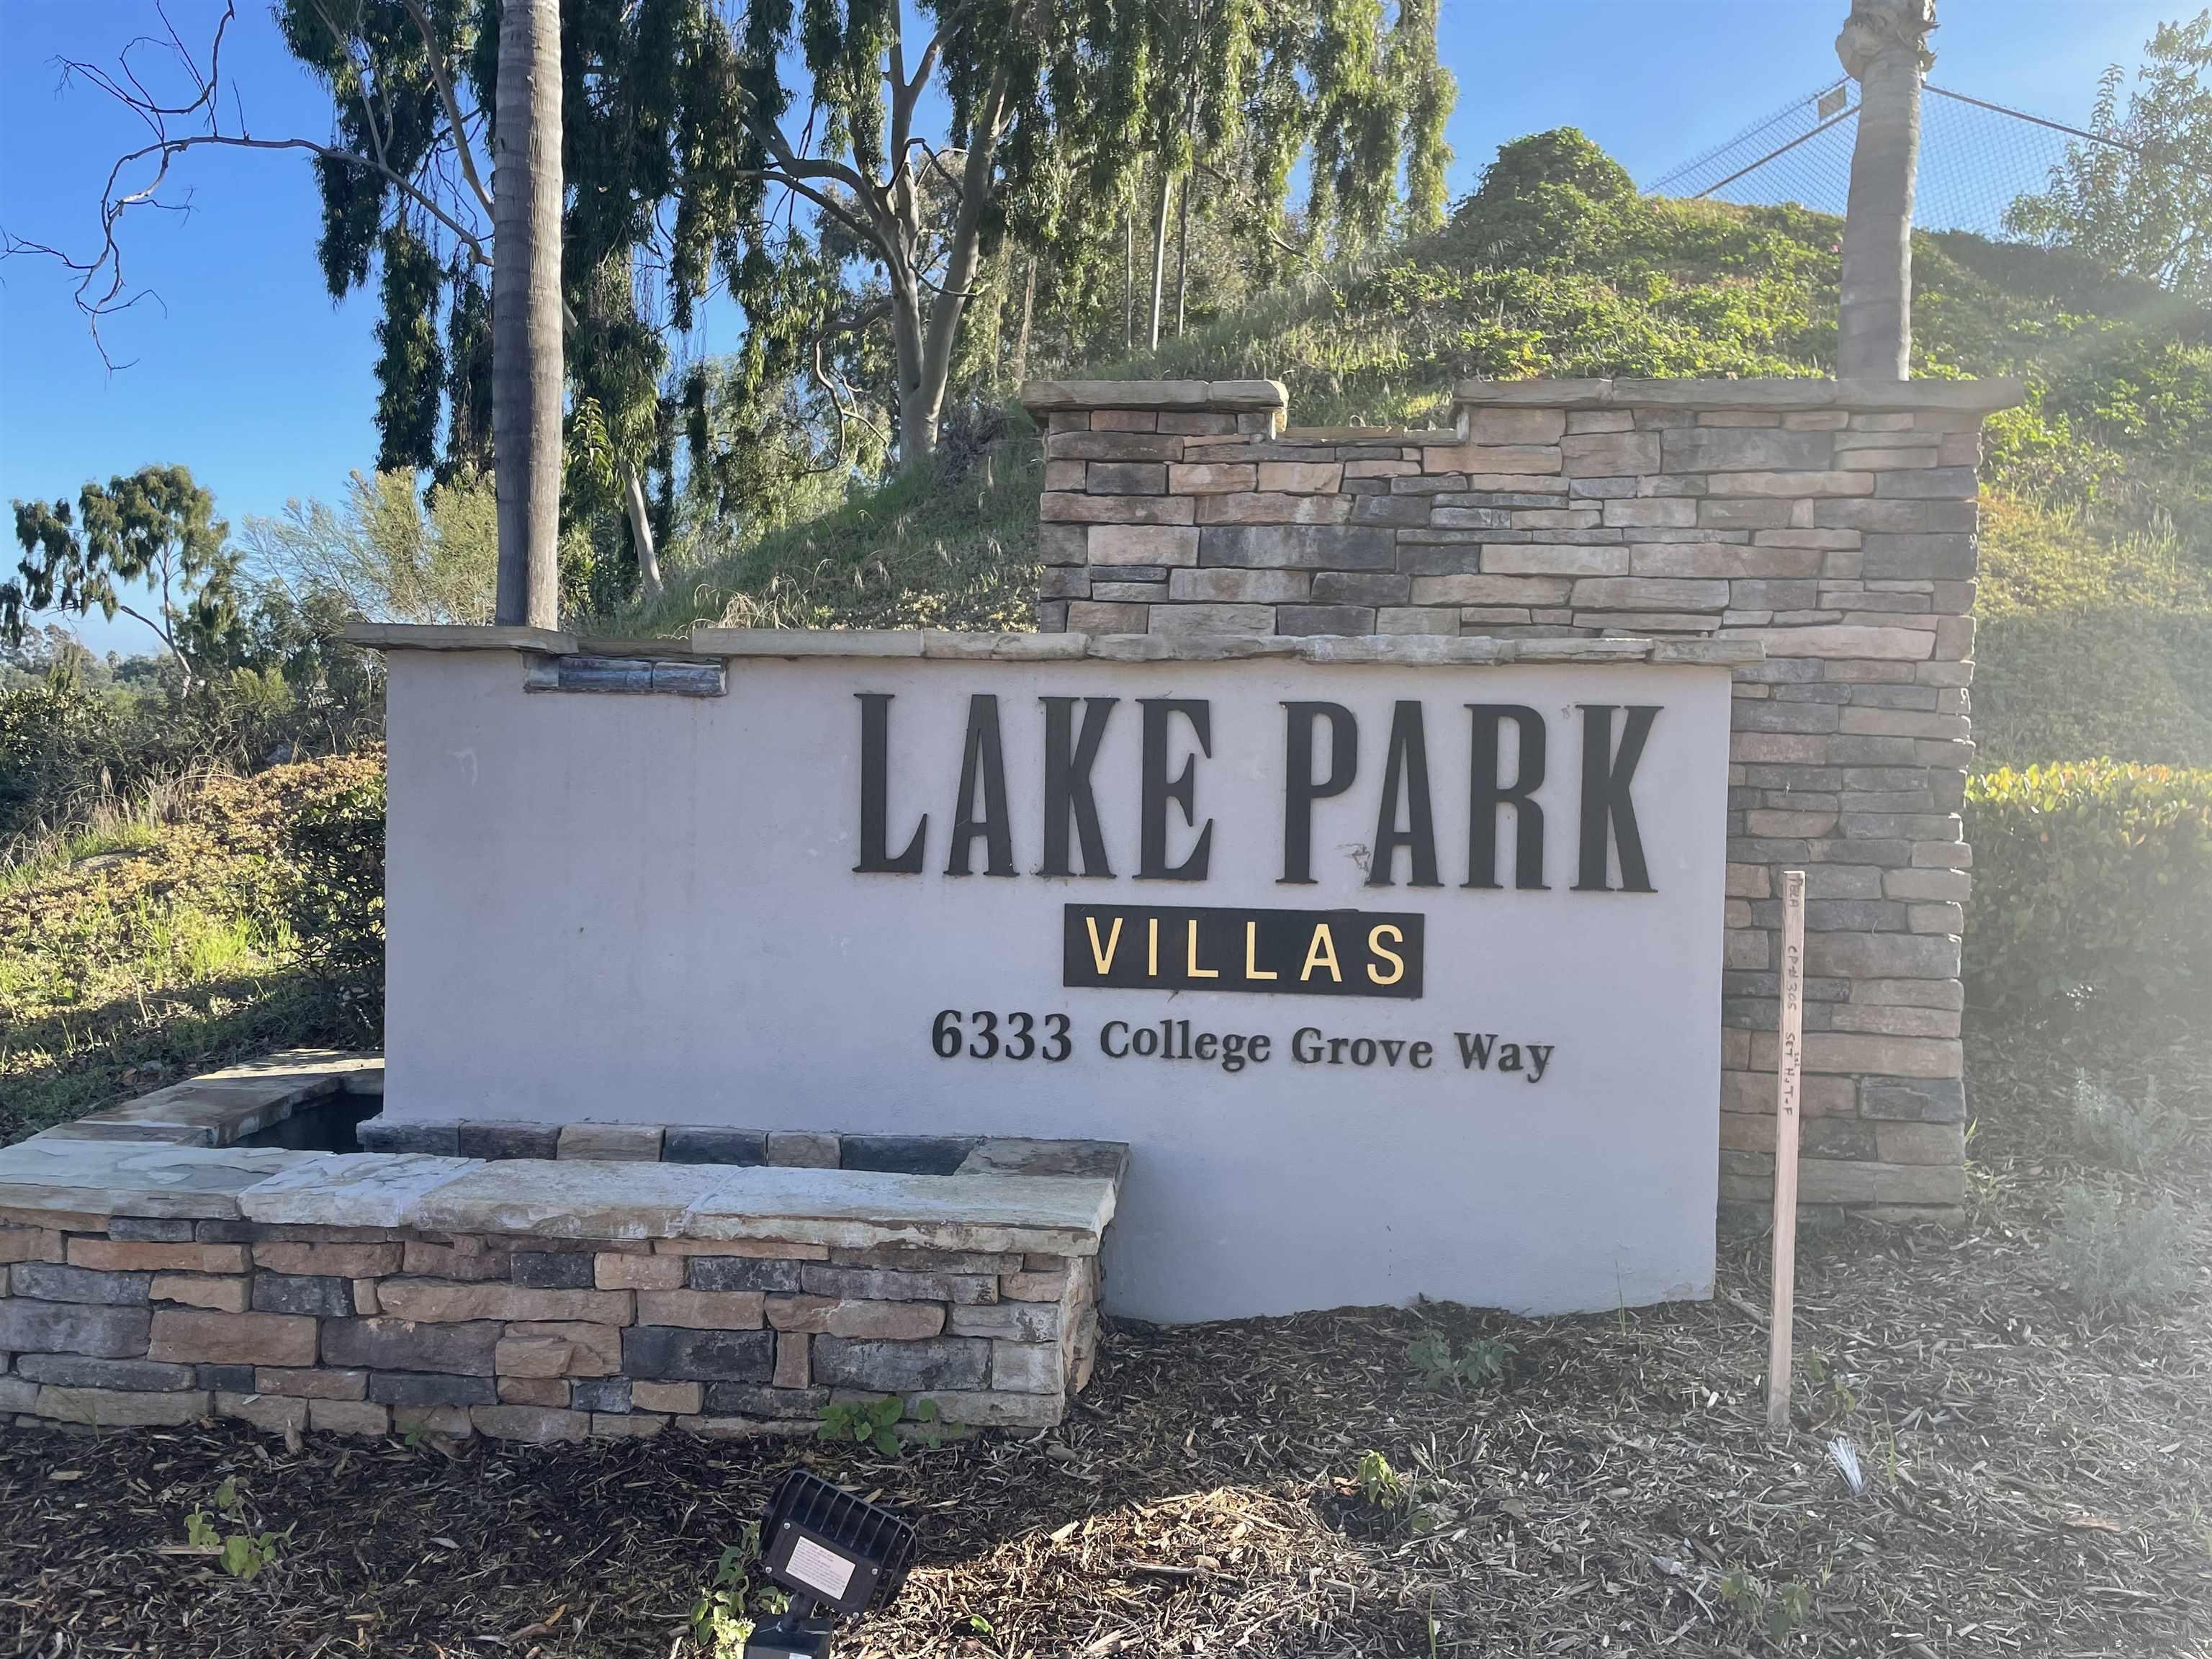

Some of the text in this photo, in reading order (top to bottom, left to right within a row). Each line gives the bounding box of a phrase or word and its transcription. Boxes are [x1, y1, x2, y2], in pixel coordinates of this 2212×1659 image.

[852, 693, 1665, 894] LAKE PARK
[1087, 917, 1404, 985] VILLAS
[932, 1010, 1555, 1084] 6333 College Grove Way
